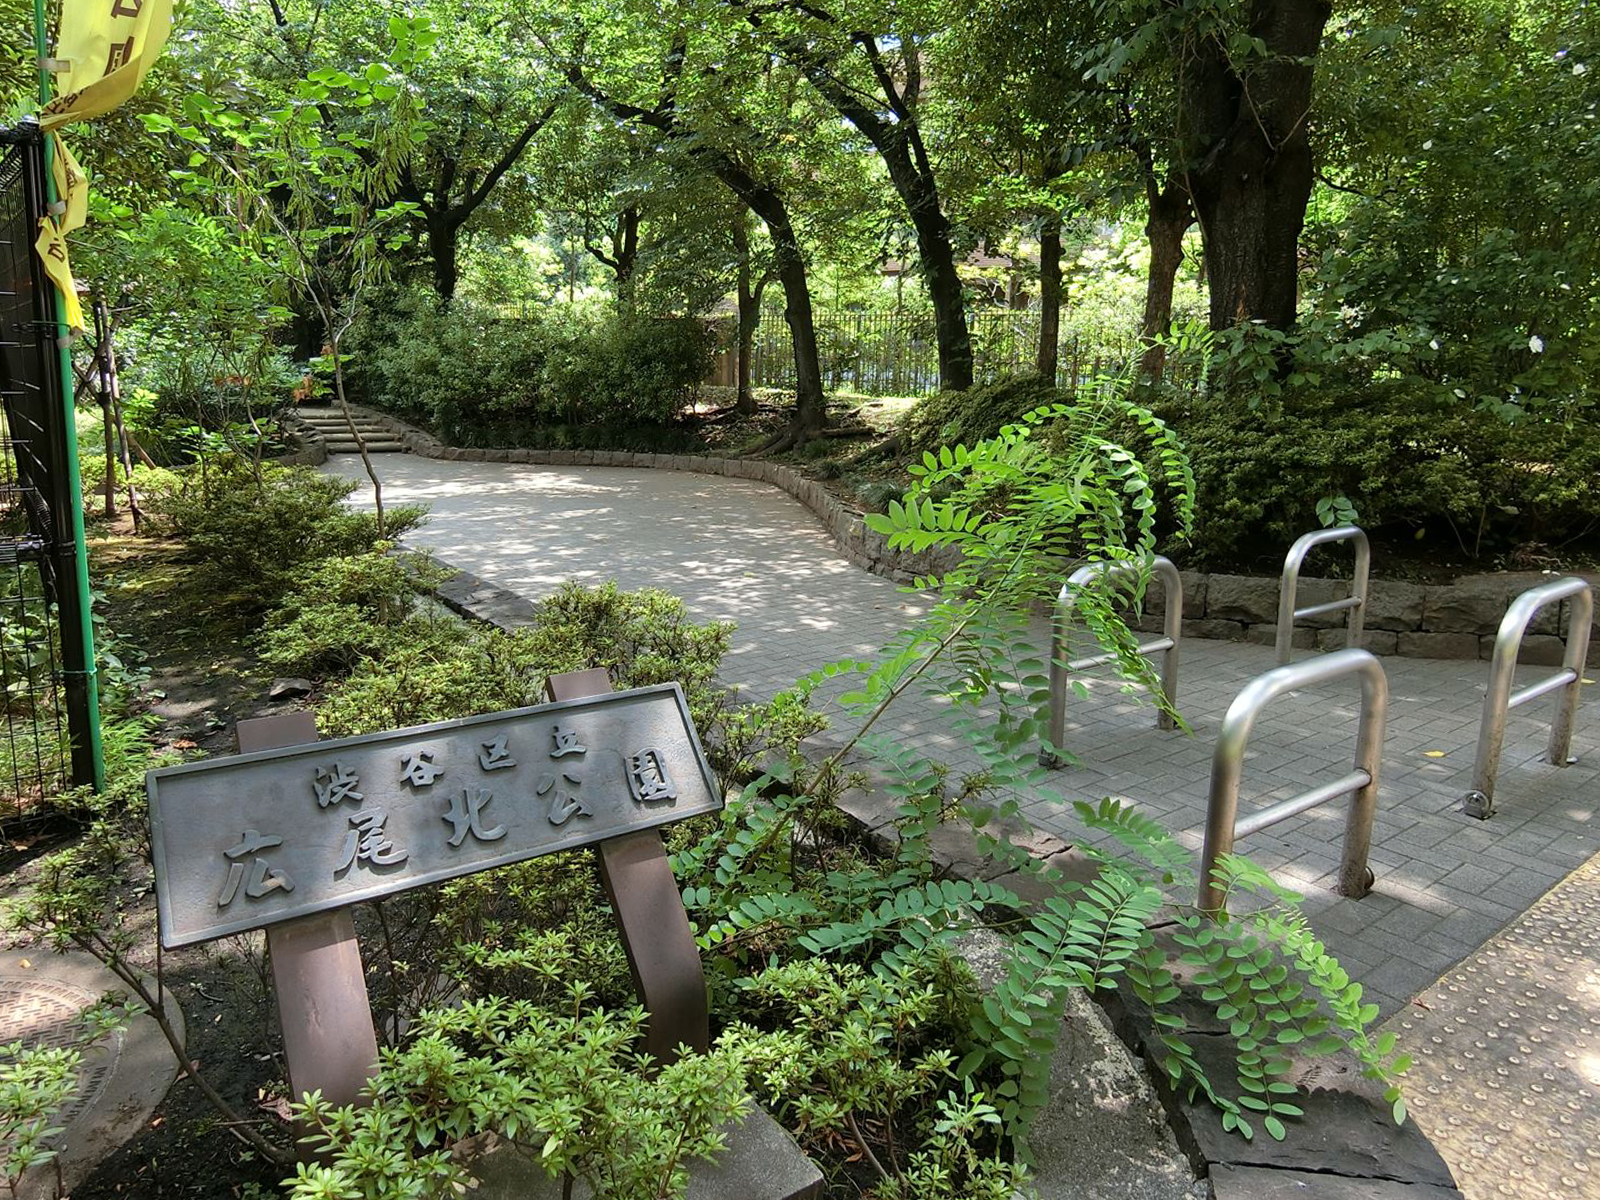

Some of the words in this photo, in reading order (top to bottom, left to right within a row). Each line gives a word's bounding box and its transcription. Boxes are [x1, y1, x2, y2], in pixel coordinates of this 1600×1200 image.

[313, 726, 587, 808] 渋谷区立
[218, 748, 678, 907] 広尾北公園
